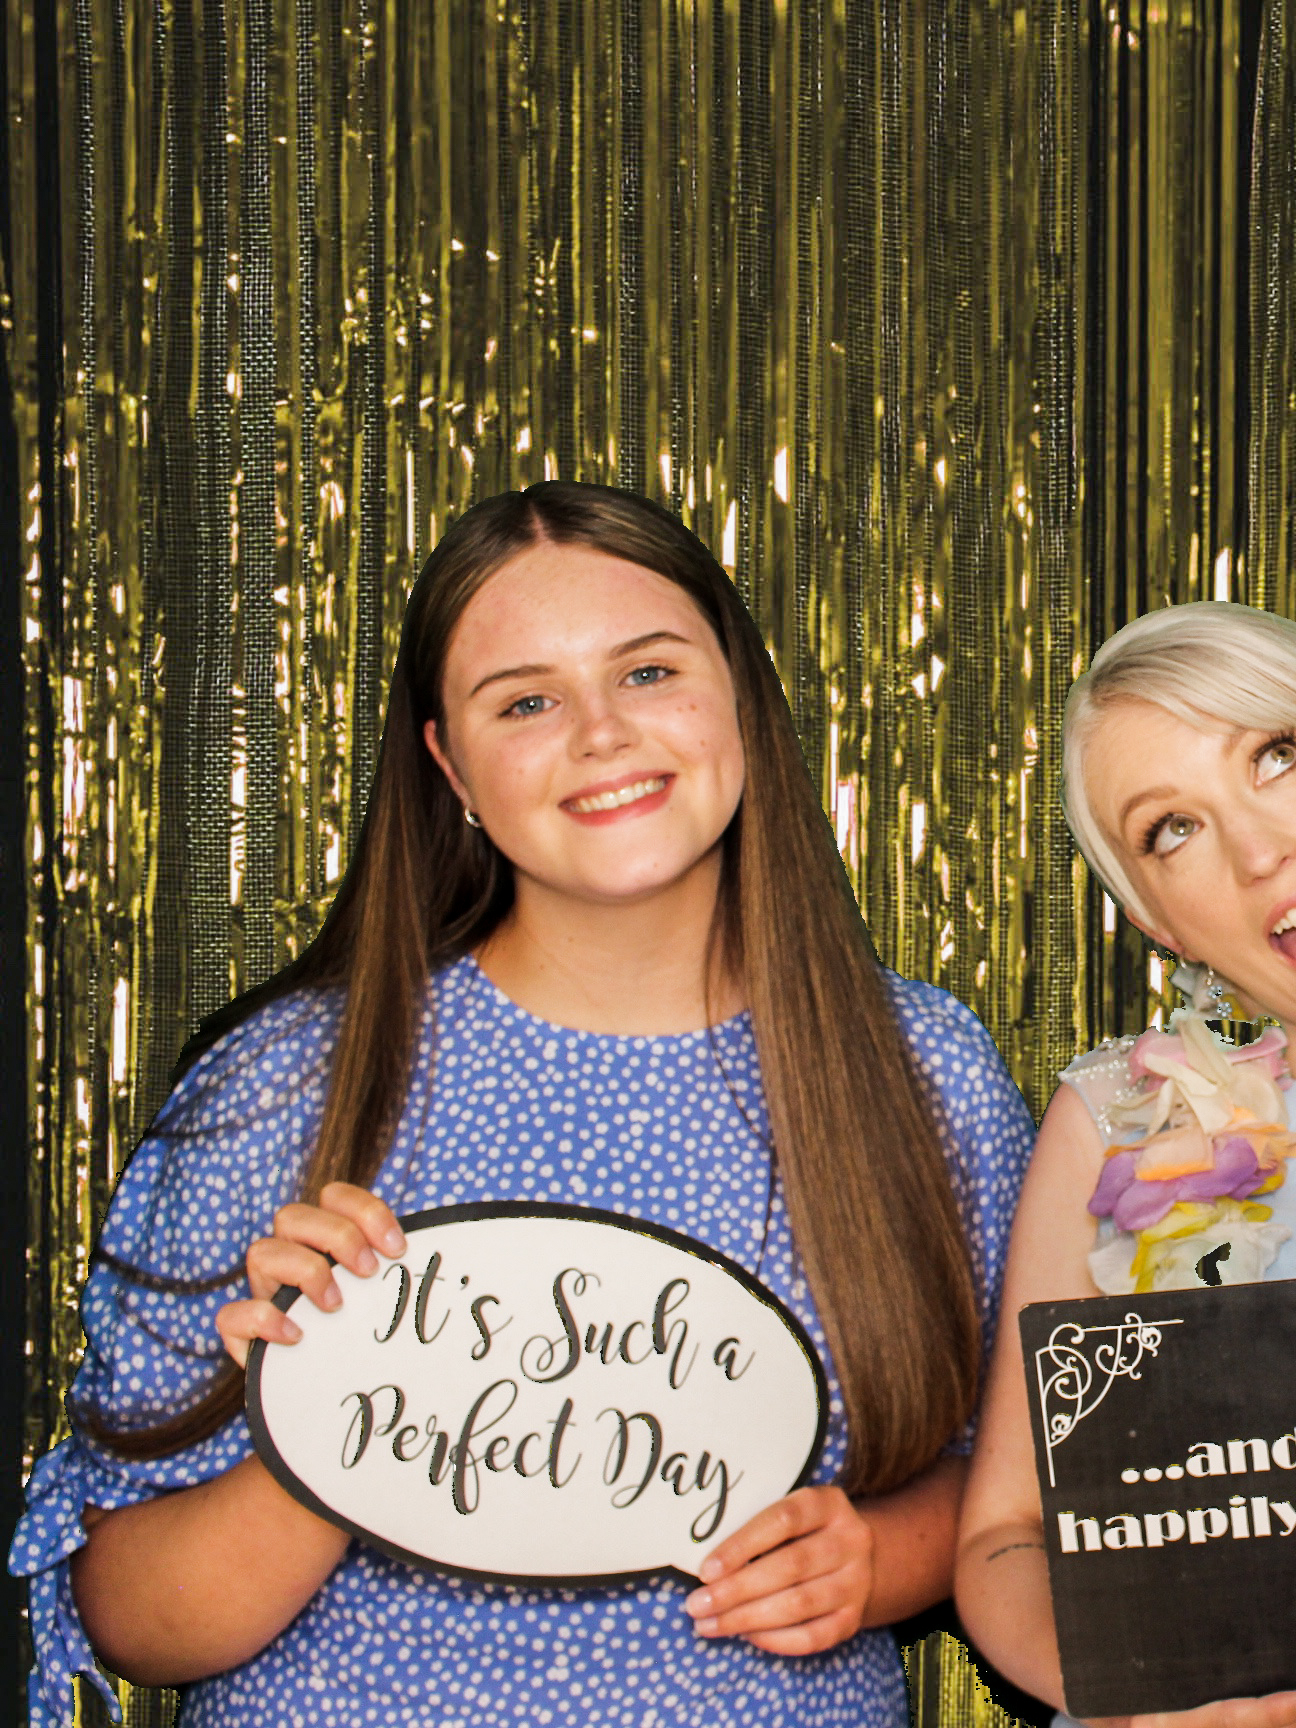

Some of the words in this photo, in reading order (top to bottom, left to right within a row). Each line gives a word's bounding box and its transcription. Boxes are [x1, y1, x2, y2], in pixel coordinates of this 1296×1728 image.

[374, 1251, 512, 1360] It's
[520, 1267, 699, 1389] Such
[713, 1337, 755, 1380] a
[340, 1379, 582, 1515] Perfect
[595, 1407, 744, 1543] Day
